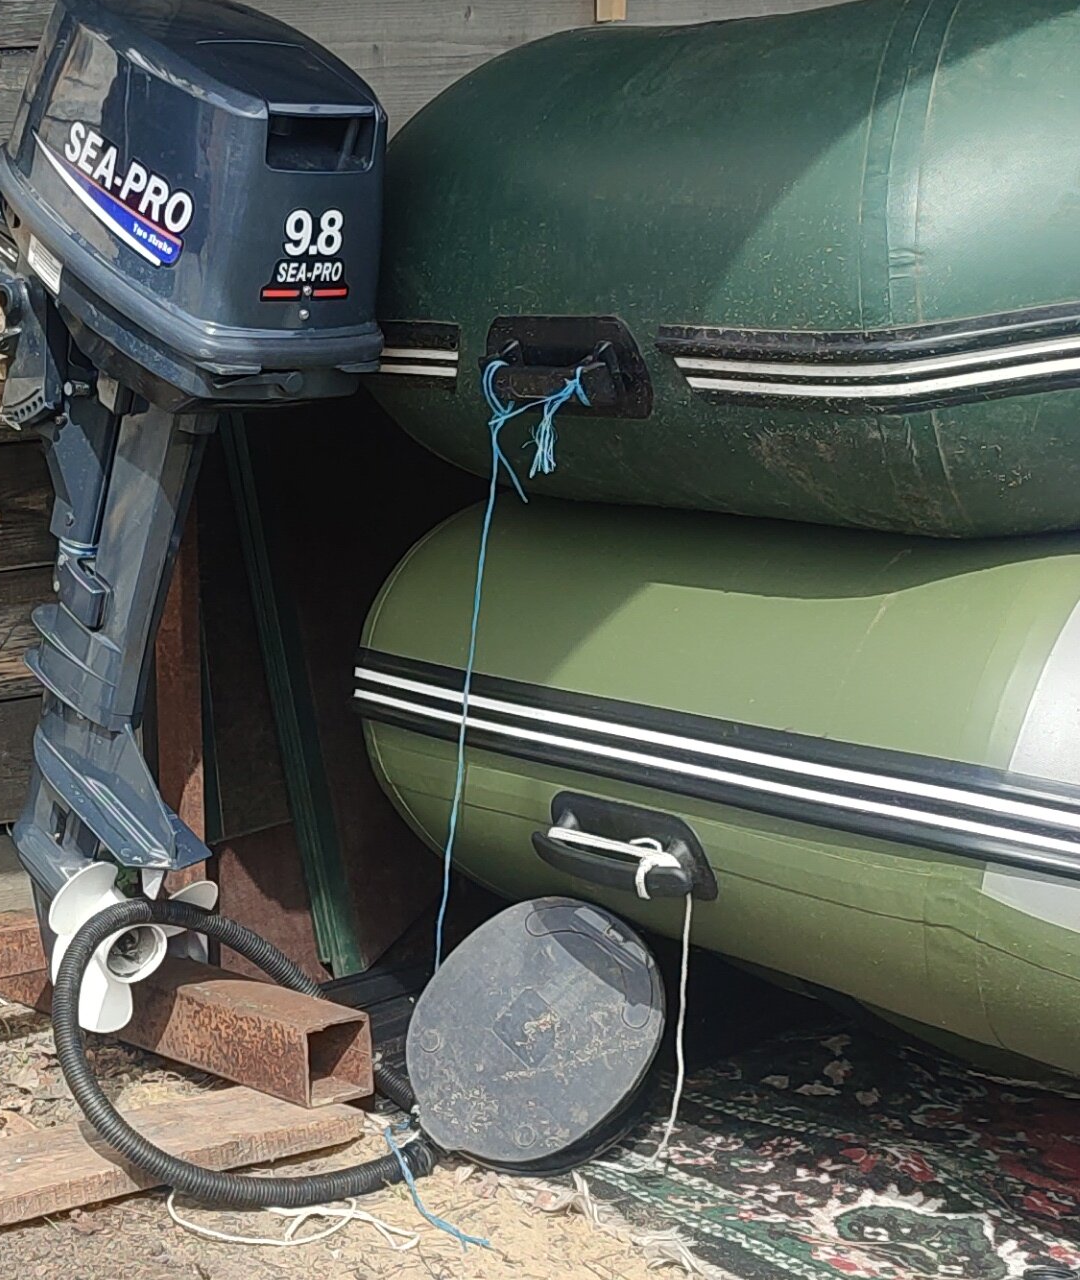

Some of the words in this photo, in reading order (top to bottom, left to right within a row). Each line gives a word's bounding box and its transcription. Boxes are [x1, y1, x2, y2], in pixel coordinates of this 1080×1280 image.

[64, 121, 193, 233] SEA-PRO
[284, 209, 344, 256] 9.8
[276, 261, 343, 283] SEA-PRO
